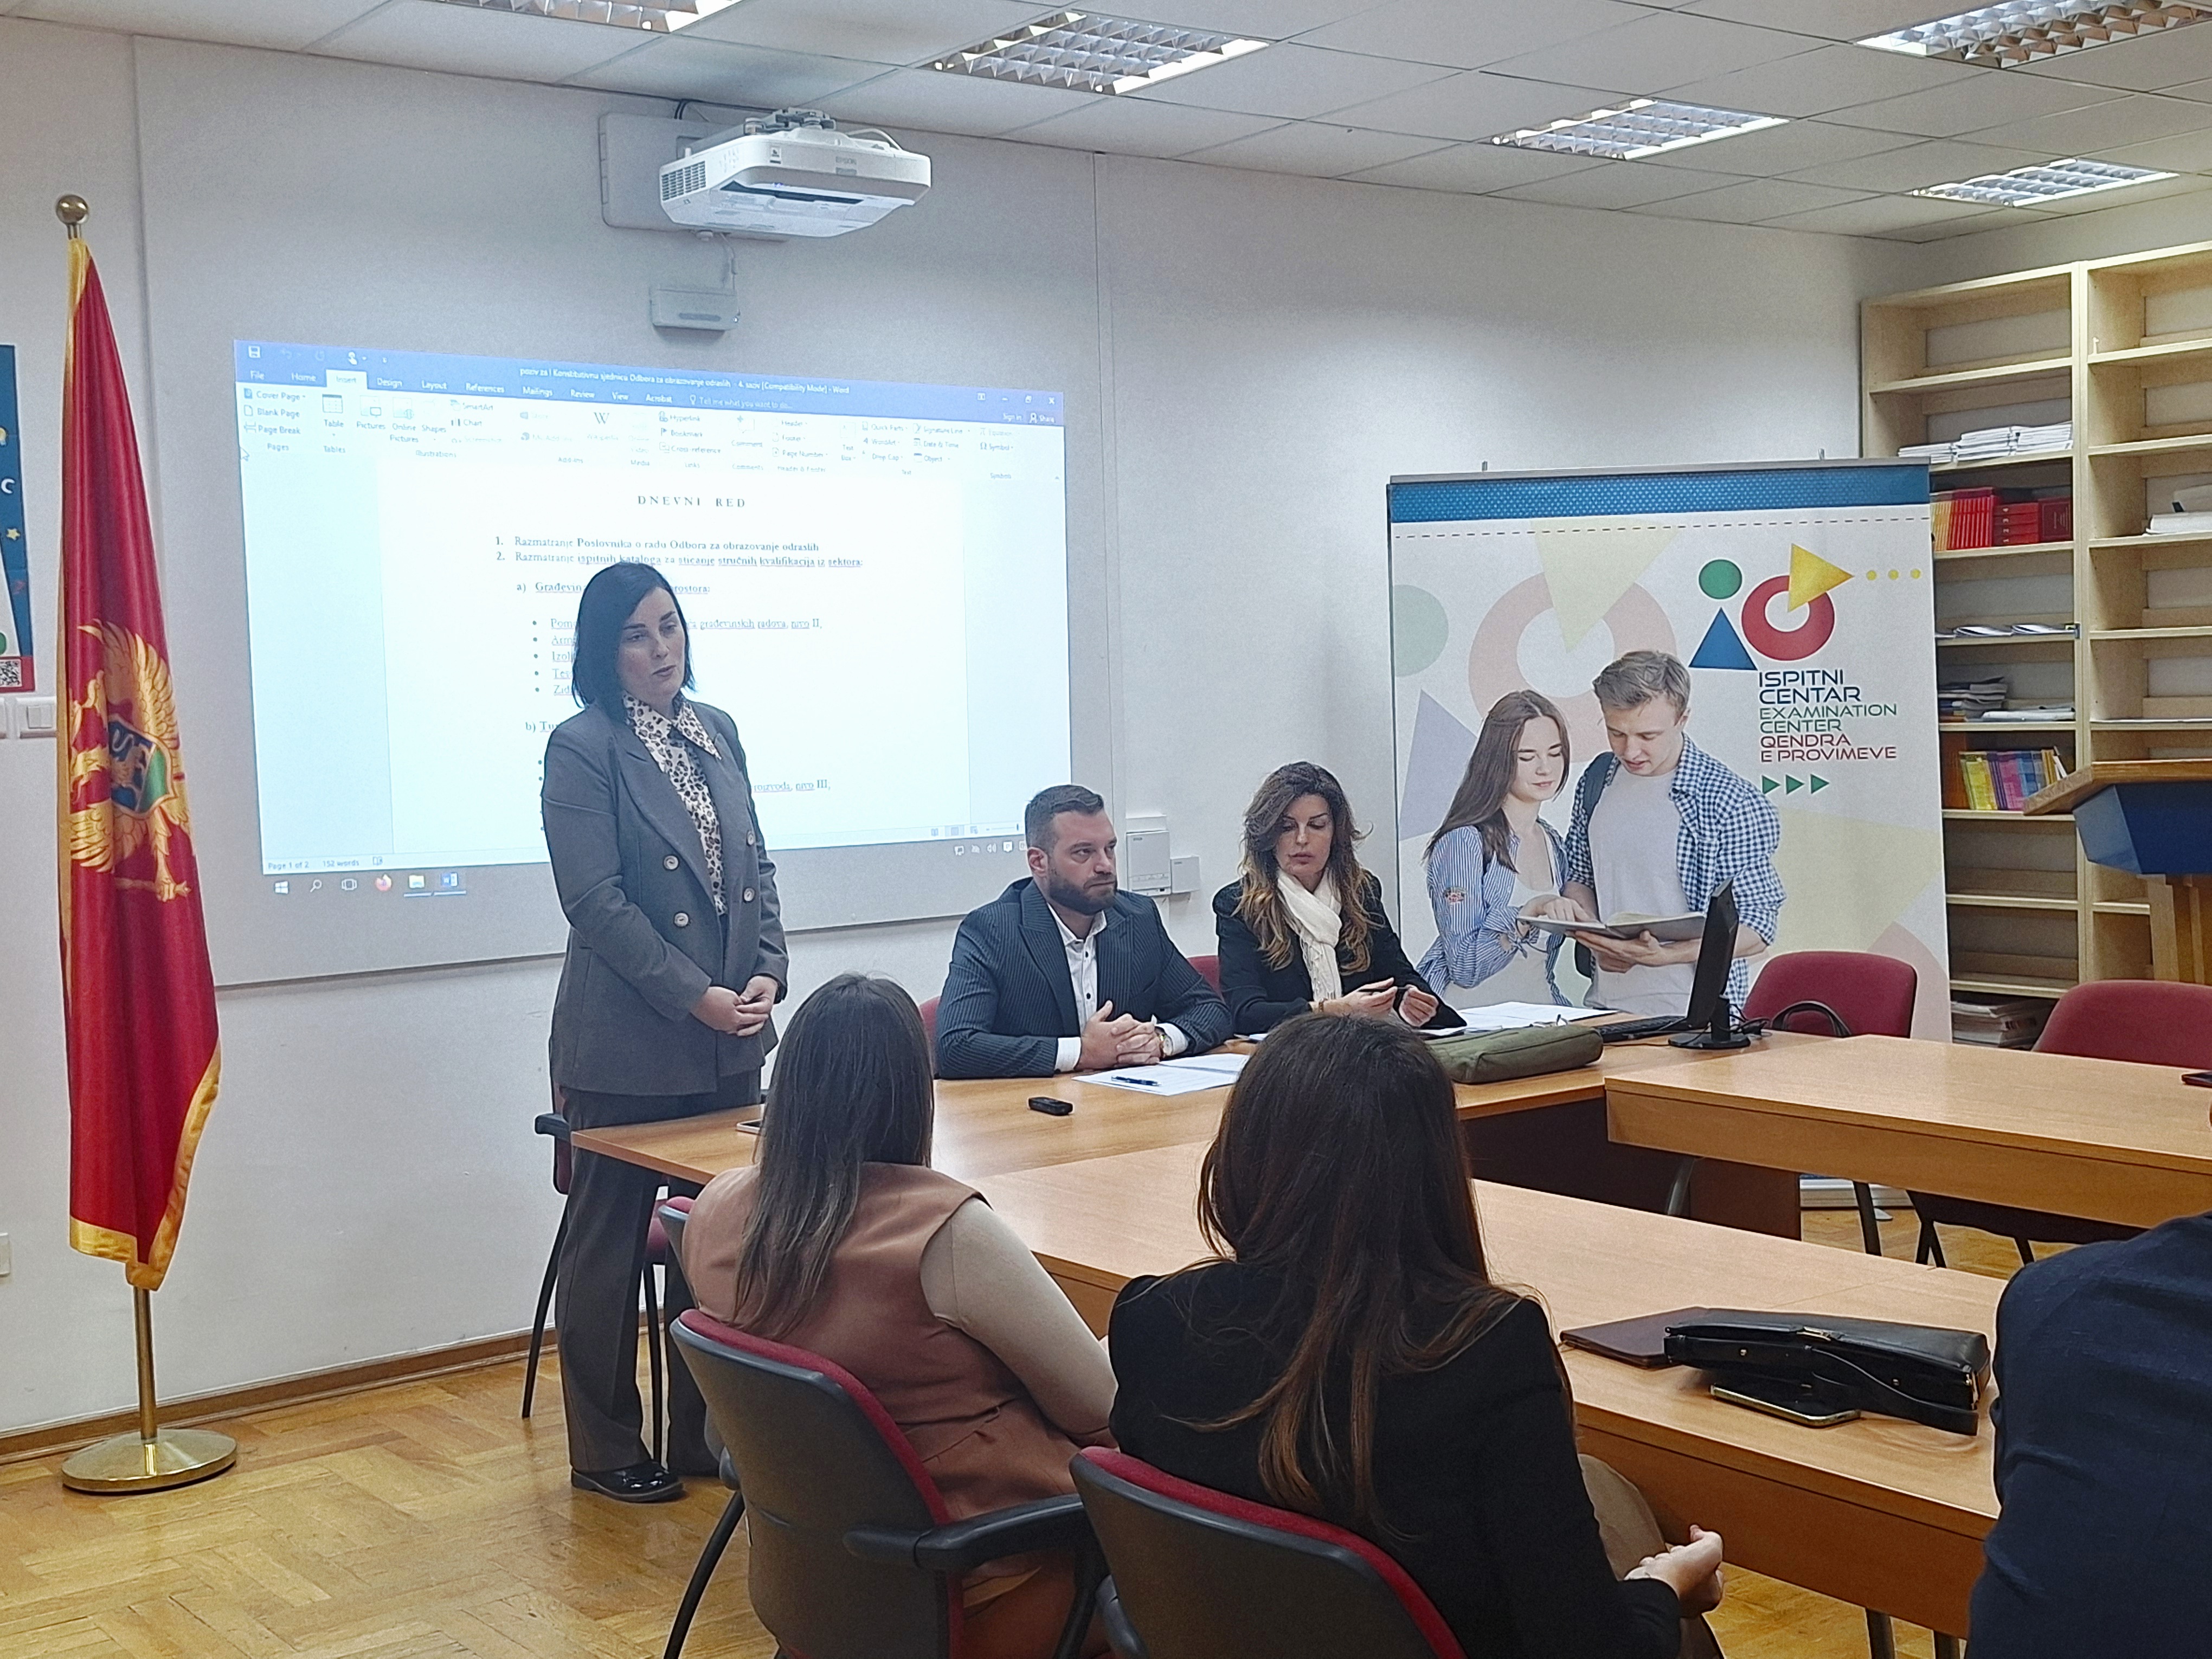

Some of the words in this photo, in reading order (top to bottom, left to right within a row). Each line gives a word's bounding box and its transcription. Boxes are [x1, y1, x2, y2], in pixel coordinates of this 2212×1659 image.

[249, 369, 265, 380] File
[291, 372, 317, 382] Home
[336, 375, 357, 384] Insert
[377, 377, 403, 389] Design
[421, 380, 448, 390] Layout
[465, 382, 505, 394] References
[522, 385, 554, 397] Mailings
[570, 389, 595, 398] Review
[612, 391, 629, 400] View
[833, 385, 850, 394] Word
[256, 391, 279, 400] Cover
[281, 391, 300, 402] Page
[257, 408, 279, 416] Blank
[280, 409, 300, 420] Page
[324, 419, 345, 428] Table
[356, 421, 386, 430] Pictures
[463, 418, 483, 427] Chart
[258, 425, 278, 435] Page
[279, 425, 301, 435] Break
[421, 425, 447, 434] Shapes
[389, 434, 419, 443] Pictures
[267, 442, 290, 452] Pages
[323, 445, 346, 454] Tables
[496, 536, 504, 545] 1.
[515, 536, 574, 549] Razmatranje
[577, 537, 632, 548] Poslovnika
[645, 540, 667, 549] radu
[670, 540, 706, 549] Odbora
[723, 541, 780, 553] obrazovanje
[782, 542, 819, 551] odraslih
[496, 551, 505, 561] 2.
[515, 551, 574, 564] Razmatranje
[578, 553, 616, 564] ispitnih
[619, 554, 661, 565] kataloga
[679, 556, 715, 566] sticanje
[760, 556, 815, 567] kvalifikacija
[818, 557, 825, 565] iz
[828, 556, 863, 566] sektora:
[517, 582, 526, 593] a)
[672, 585, 710, 593] rostora:
[1759, 669, 1844, 687] ISPITNI
[1759, 686, 1861, 705] CENTAR
[1759, 703, 1897, 720] EXAMINATION
[525, 721, 536, 733] b)
[1760, 719, 1842, 734] CENTER
[1760, 733, 1851, 749] QENDRA
[1761, 750, 1772, 762] E
[1778, 746, 1897, 762] PROVIMEVE
[268, 862, 286, 871] Page
[337, 859, 359, 867] words
